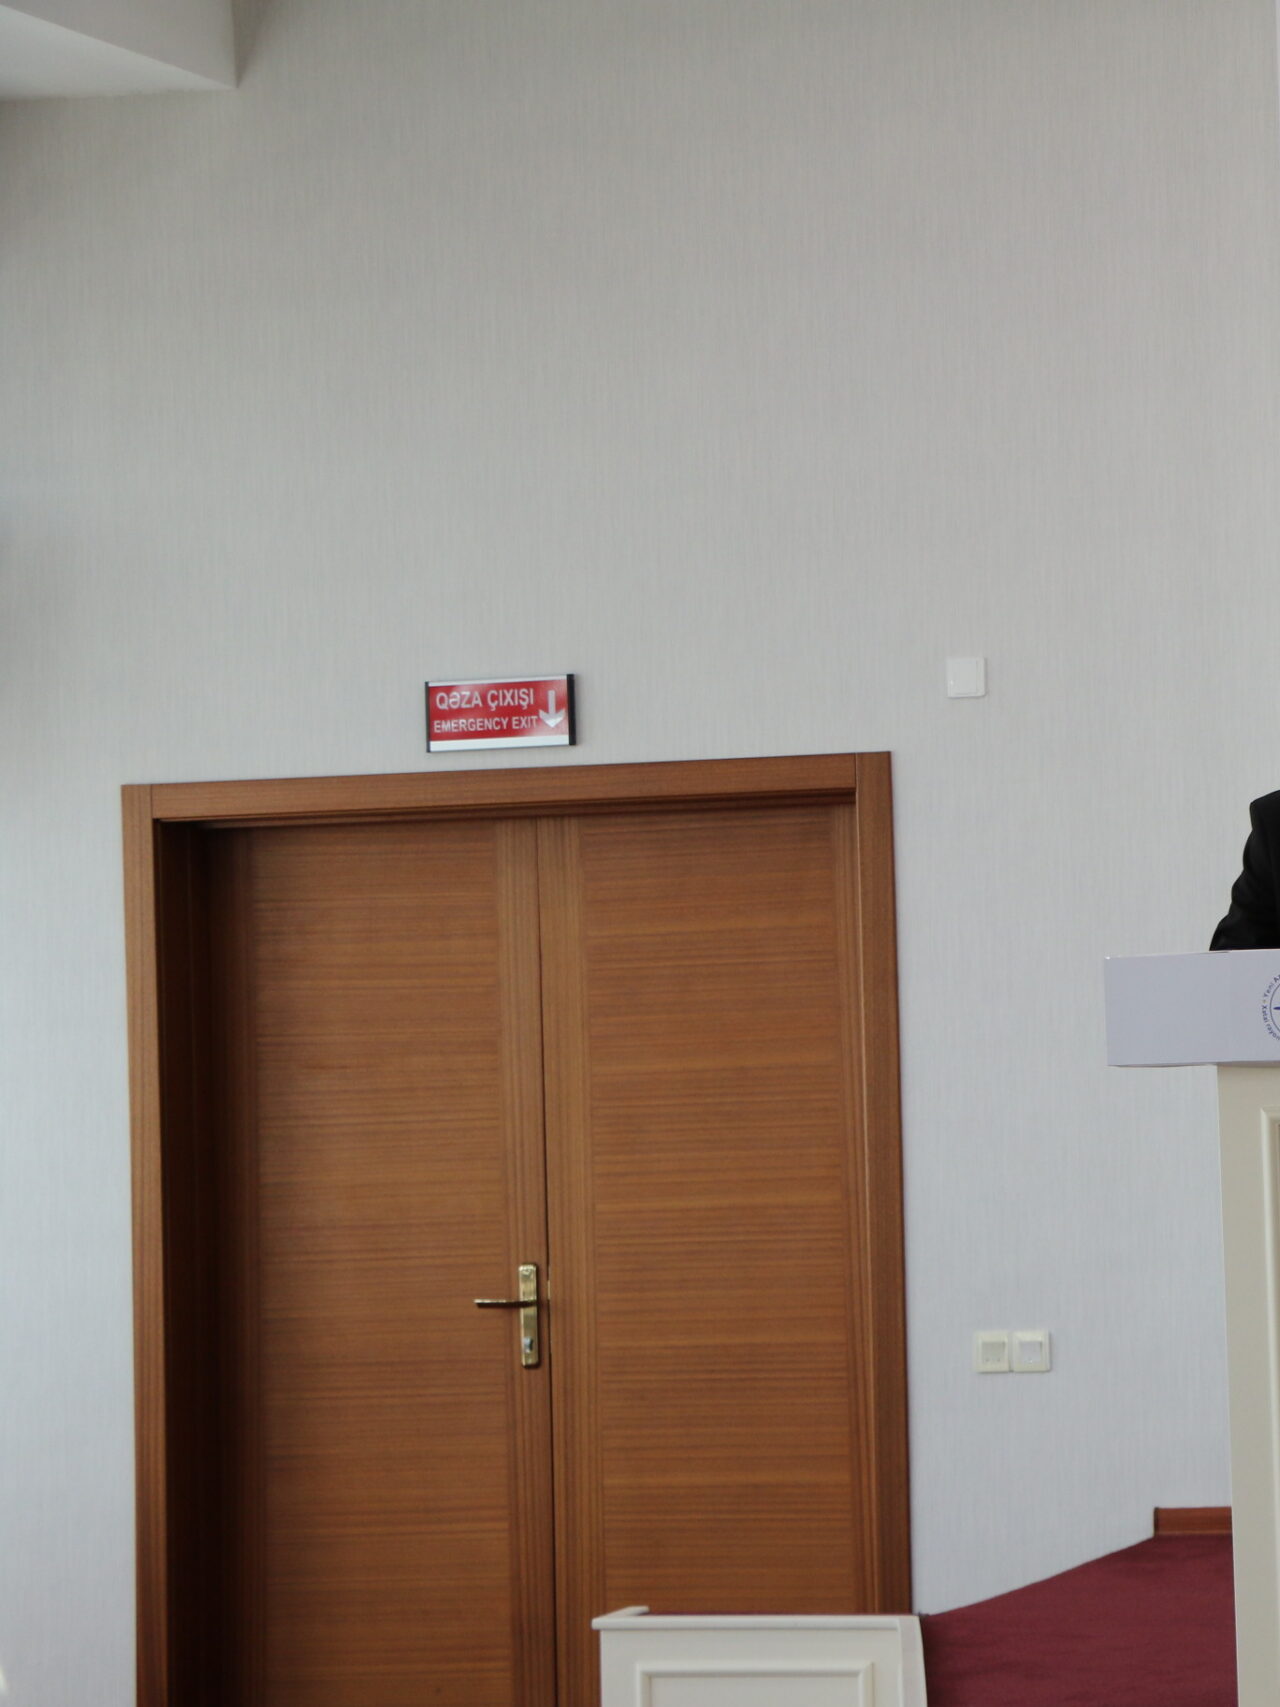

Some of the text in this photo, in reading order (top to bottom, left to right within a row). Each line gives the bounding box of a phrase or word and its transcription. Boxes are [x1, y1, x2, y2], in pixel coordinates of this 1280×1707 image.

[436, 688, 534, 711] QƏZA ÇIXIŞI
[434, 716, 538, 733] EMERGENCY EXIT
